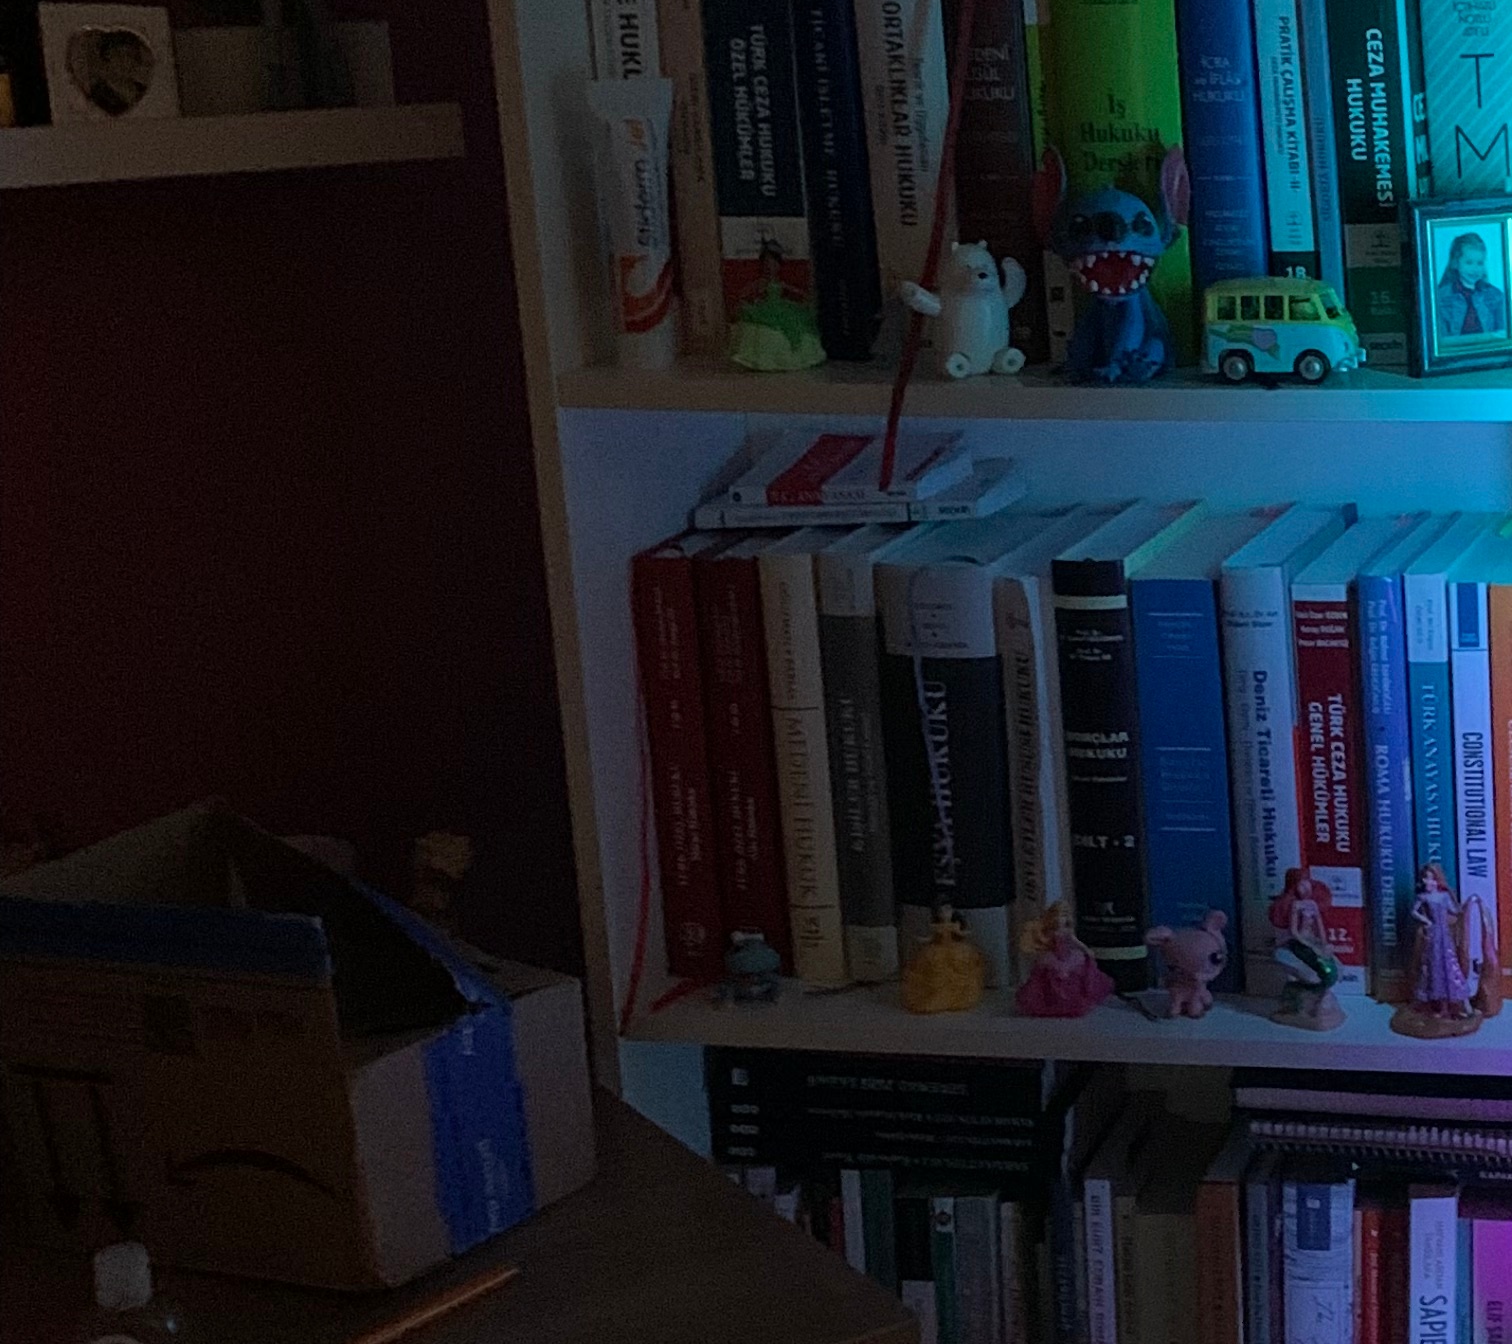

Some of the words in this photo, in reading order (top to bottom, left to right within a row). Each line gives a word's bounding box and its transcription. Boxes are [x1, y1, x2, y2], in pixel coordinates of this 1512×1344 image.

[728, 37, 750, 84] ÖZEL
[748, 23, 768, 71] TÜRK
[881, 1, 912, 137] ORTAKLIKLAR
[1278, 16, 1294, 65] PRATİK
[1365, 28, 1386, 78] CEZA
[755, 75, 771, 119] CEZA
[1280, 69, 1297, 127] ÇALIŞMA
[1345, 78, 1369, 163] HUKUKU
[733, 86, 756, 181] HÜKÜMLER
[757, 123, 778, 198] HUKUKU
[1080, 121, 1160, 143] Hukuku
[1286, 131, 1301, 175] KİTABI
[1455, 122, 1511, 179] M
[893, 144, 918, 228] HUKUKU
[1252, 670, 1270, 722] Deniz
[1327, 693, 1345, 738] TÜRK
[1420, 684, 1438, 729] TÜRK
[1308, 702, 1326, 752] GENEL
[1256, 729, 1277, 802] Ticareti
[1330, 742, 1346, 782] CEZA
[1373, 744, 1390, 797] ROMA
[1422, 731, 1441, 814] ANAYASA
[1462, 731, 1487, 845] CONSTITUTIONAL
[1311, 755, 1332, 843] HÜKÜMLER
[1332, 785, 1350, 853] HUKUKU
[1261, 807, 1279, 878] Hukuku
[1376, 800, 1394, 872] HUKUKU
[1466, 848, 1488, 878] LAW
[1379, 876, 1399, 947] DERSLERİ
